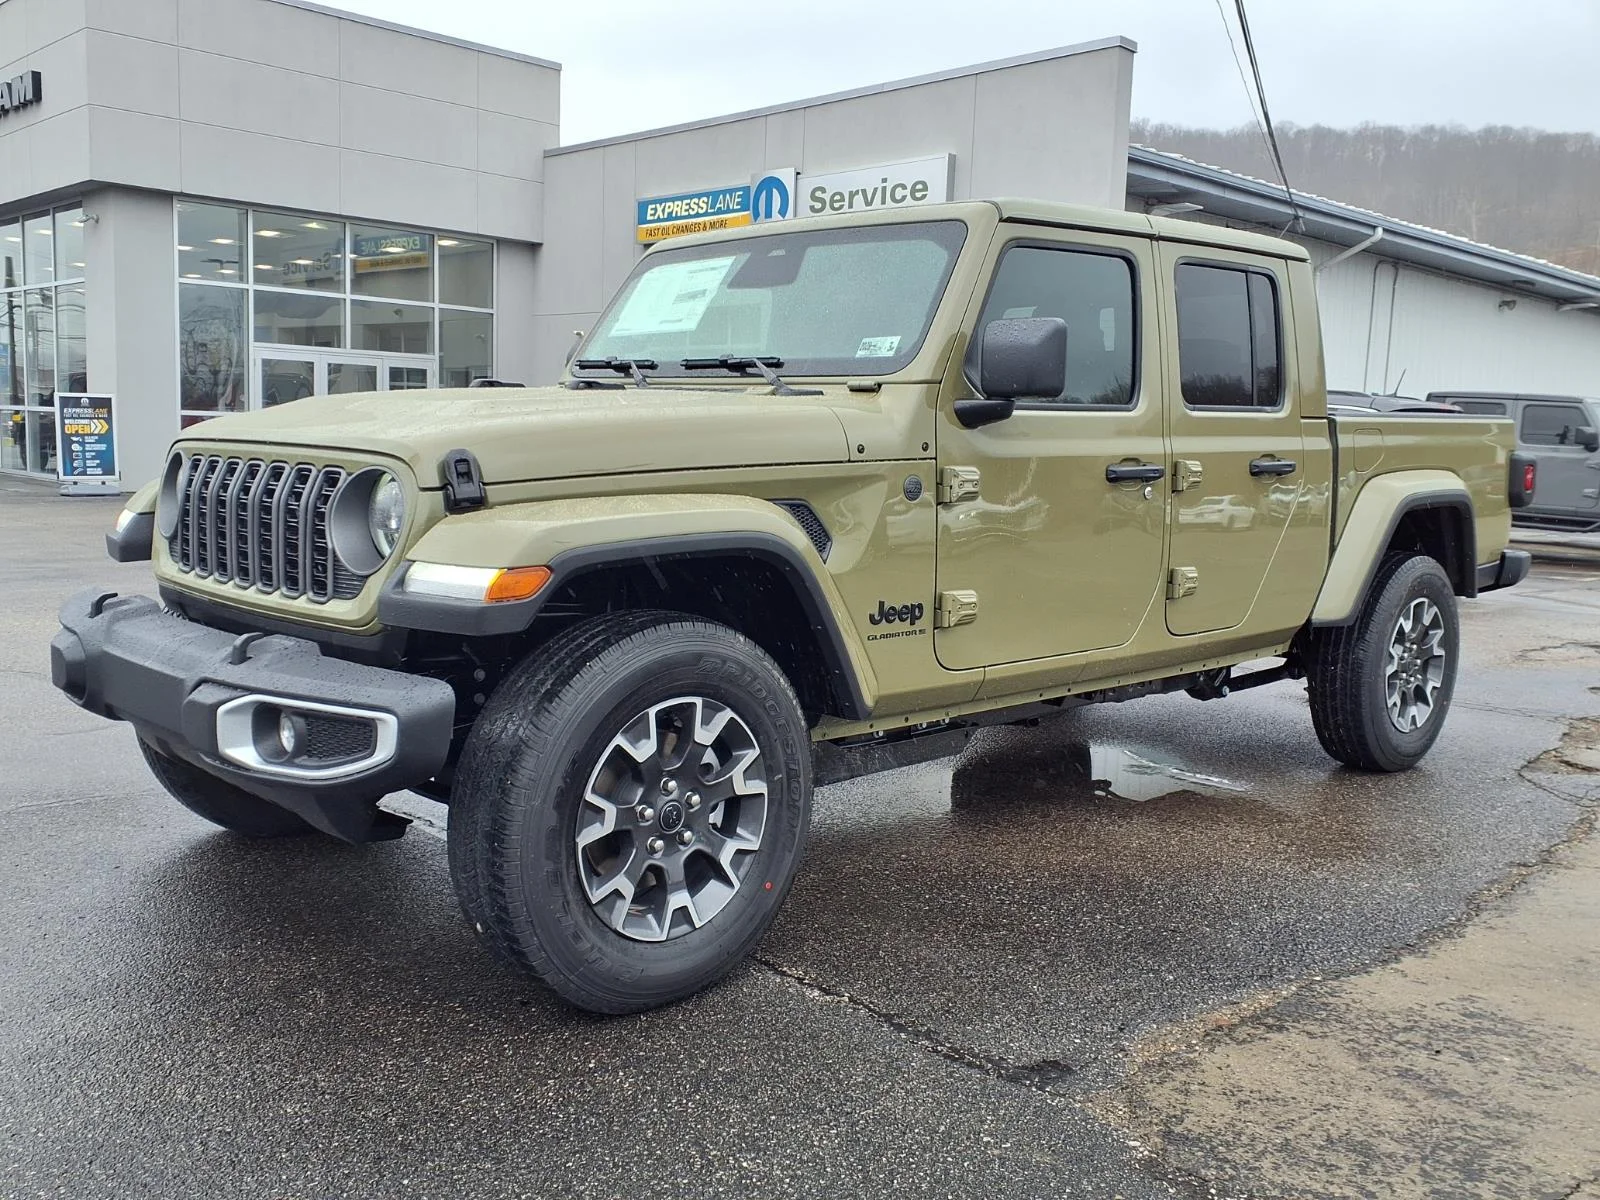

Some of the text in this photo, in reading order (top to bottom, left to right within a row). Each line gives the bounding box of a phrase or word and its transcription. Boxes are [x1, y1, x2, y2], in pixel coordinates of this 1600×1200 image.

[646, 191, 744, 221] EXPRESSLANE
[808, 177, 929, 214] Service
[645, 219, 728, 238] FAST OIL CHANGES & MORE
[64, 424, 91, 434] OPEN
[868, 599, 924, 626] Jeep
[867, 629, 918, 641] GLADIATOR
